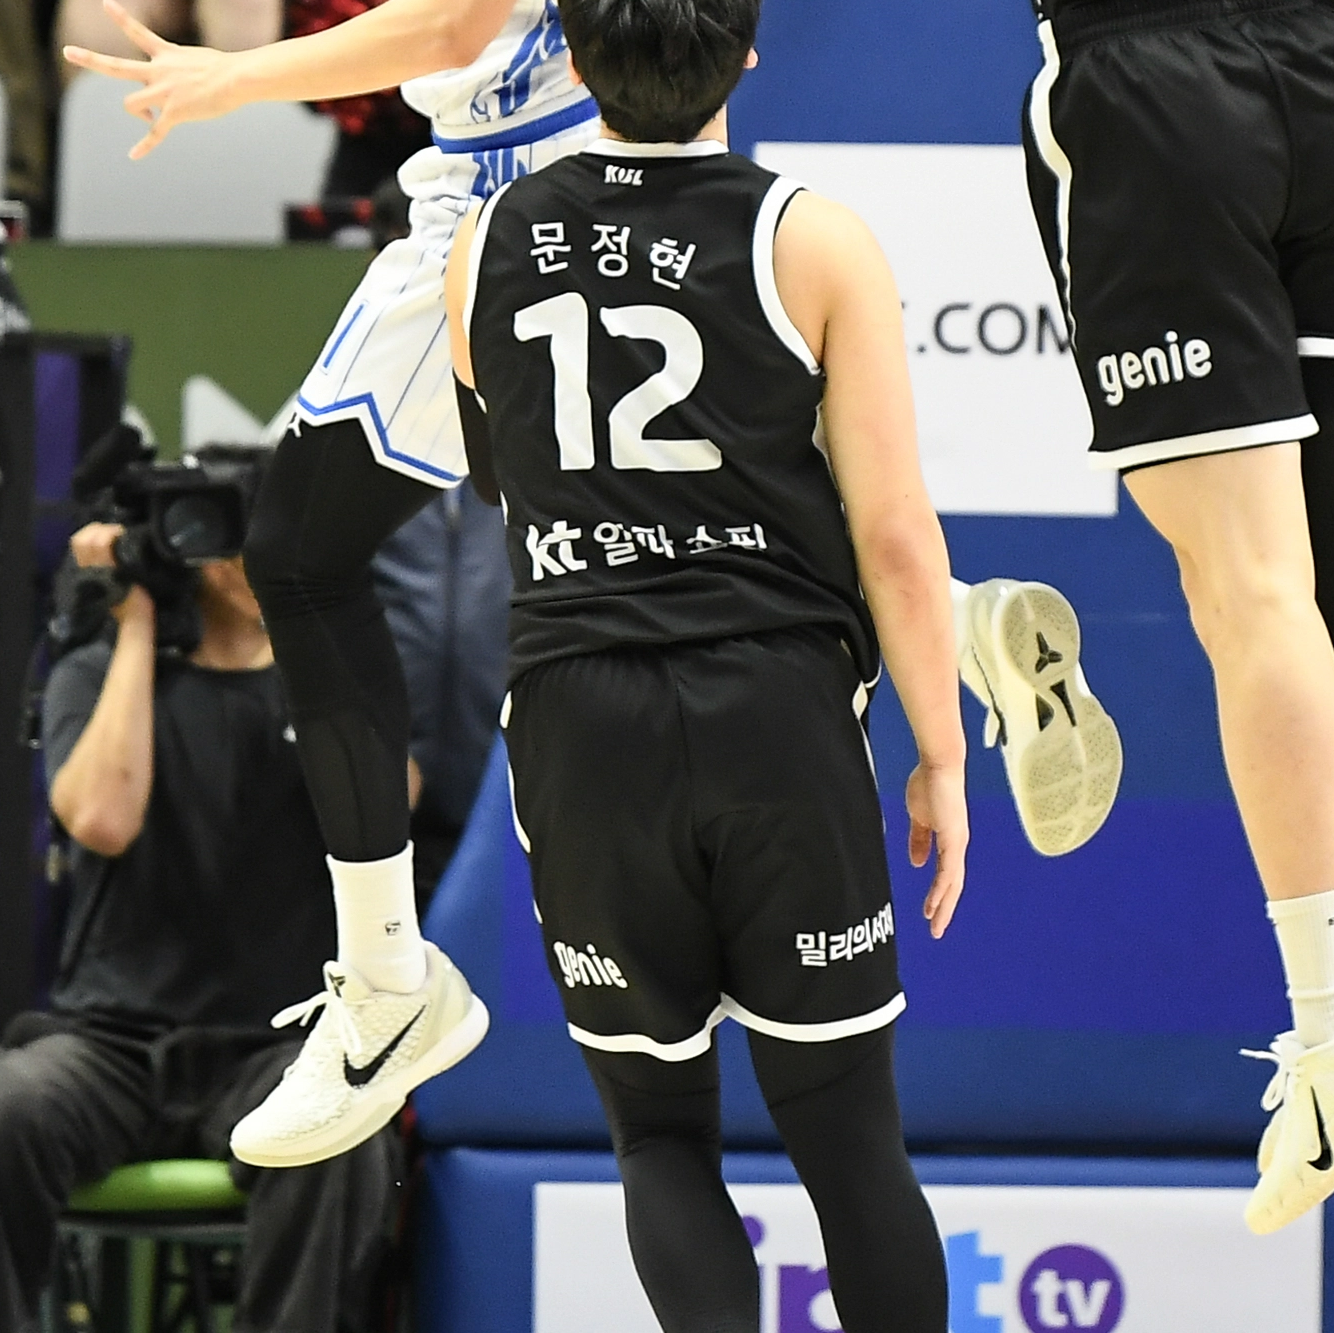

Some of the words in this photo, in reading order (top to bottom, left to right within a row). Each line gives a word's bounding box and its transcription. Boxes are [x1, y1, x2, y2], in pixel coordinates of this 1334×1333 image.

[530, 221, 697, 291] 문정현
[901, 301, 1070, 356] .COM
[513, 291, 723, 472] 12
[1097, 330, 1212, 407] genie
[553, 941, 628, 989] genie
